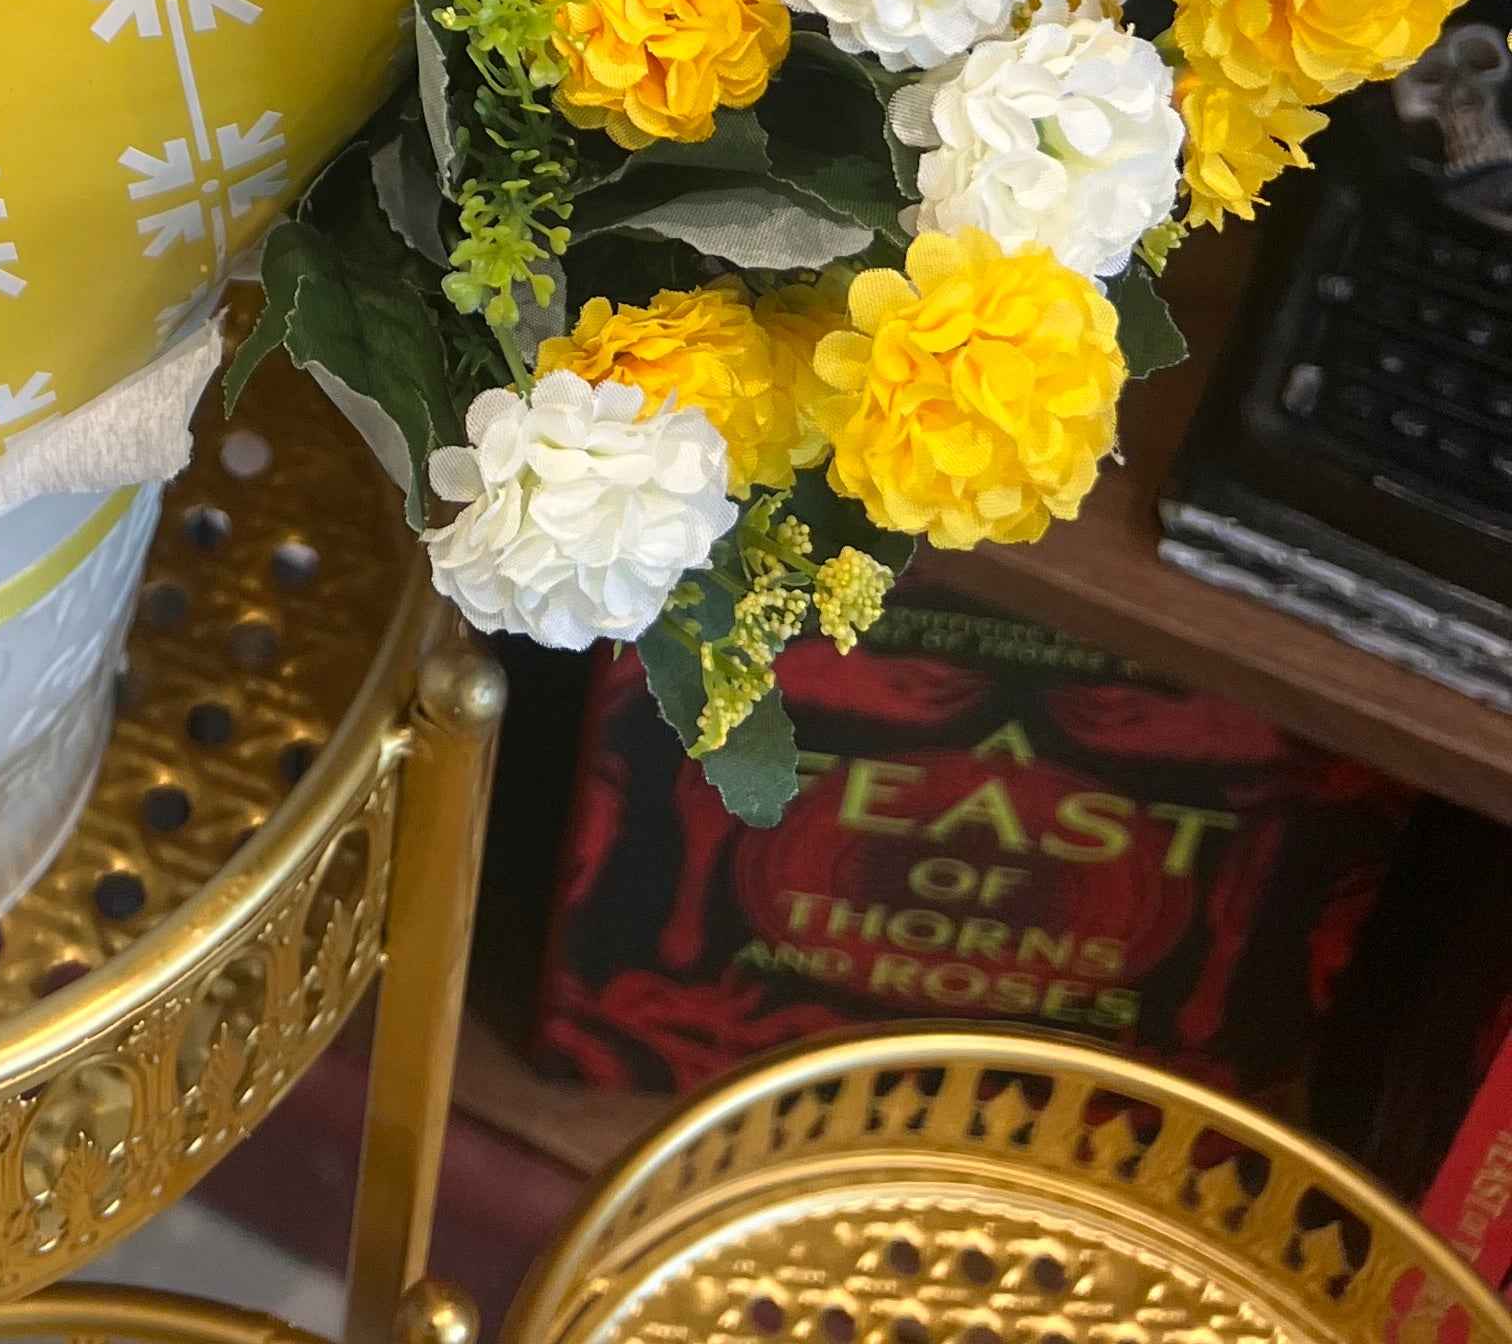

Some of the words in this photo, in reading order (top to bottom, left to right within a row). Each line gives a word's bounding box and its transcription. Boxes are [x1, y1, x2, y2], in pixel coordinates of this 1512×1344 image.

[971, 720, 1035, 768] A
[908, 855, 1034, 905] OF
[783, 888, 1129, 979] THORNS
[734, 936, 855, 982] AND
[868, 952, 1144, 1029] ROSES
